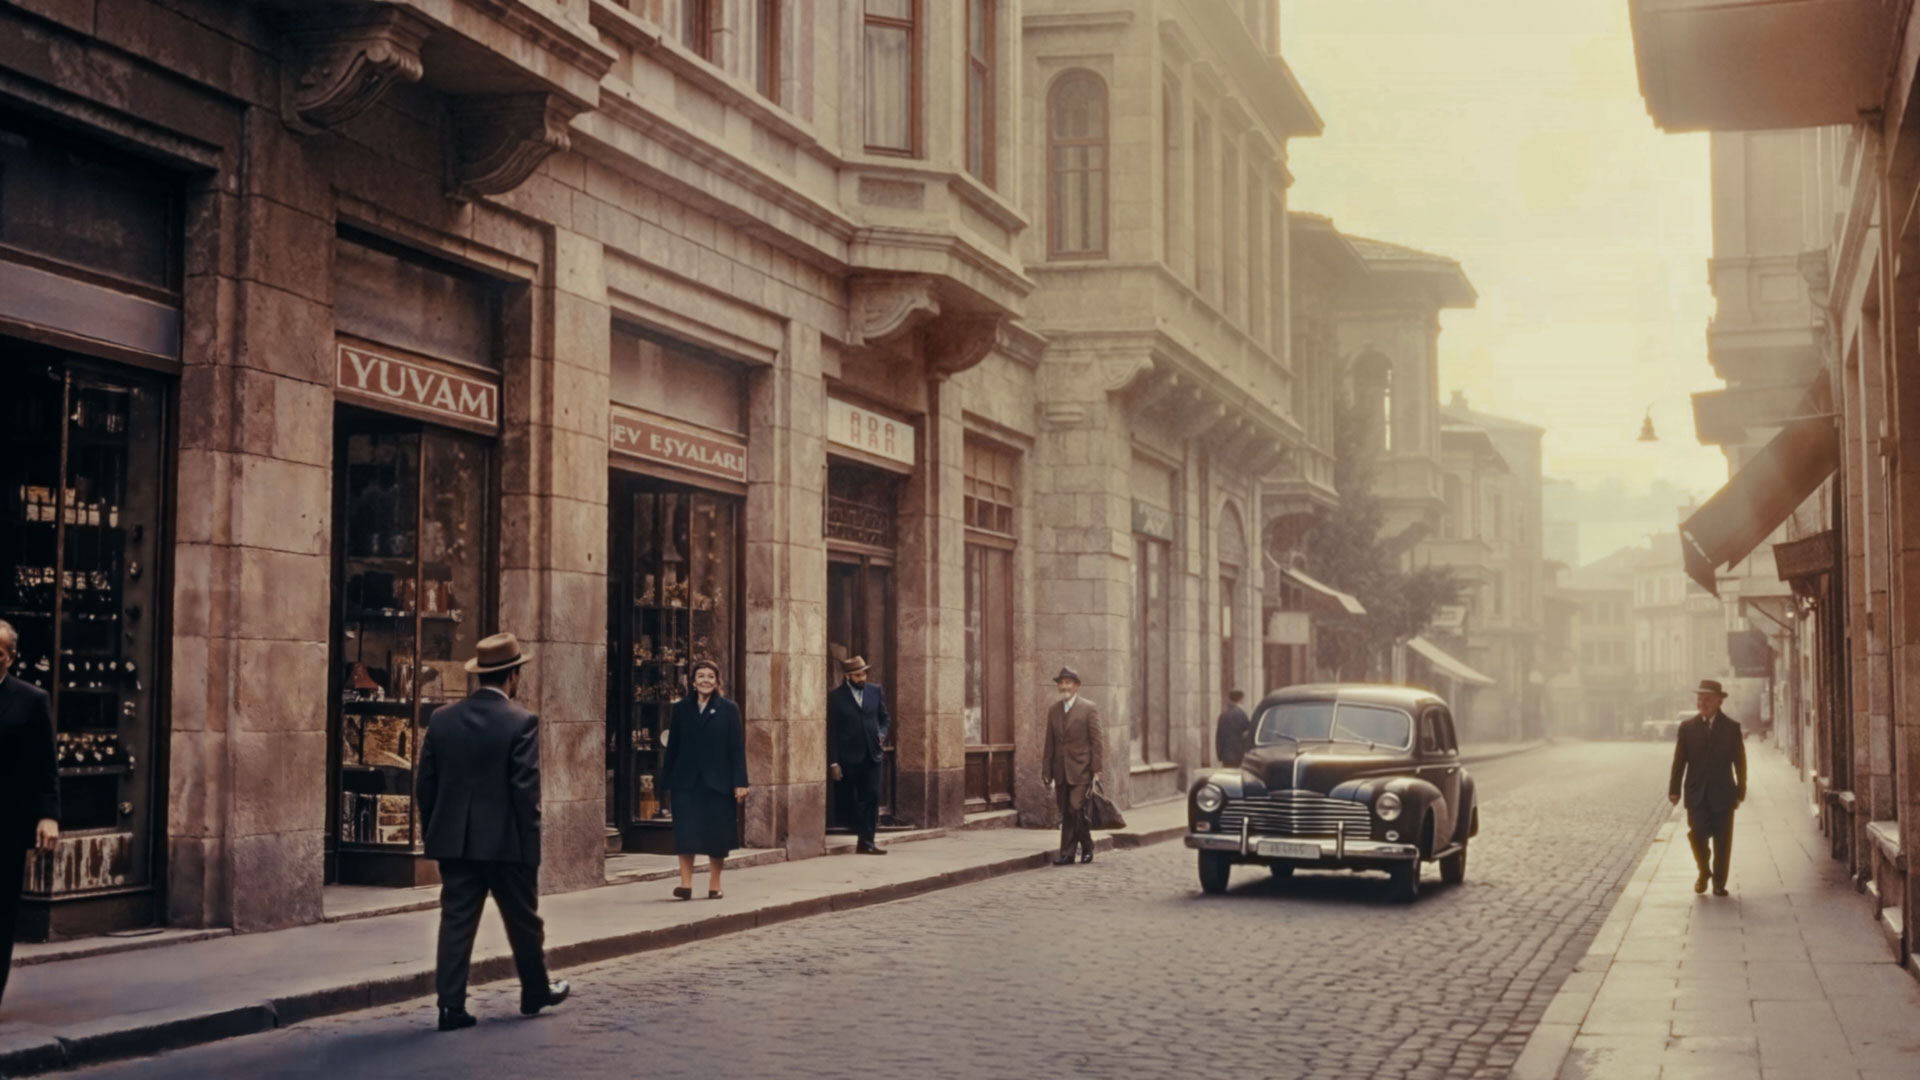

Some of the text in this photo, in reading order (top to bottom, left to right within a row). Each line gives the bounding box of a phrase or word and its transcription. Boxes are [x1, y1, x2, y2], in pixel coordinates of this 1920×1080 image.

[345, 351, 489, 419] YUVAM
[613, 424, 744, 472] EV EŞYALARI
[850, 411, 896, 439] ADA
